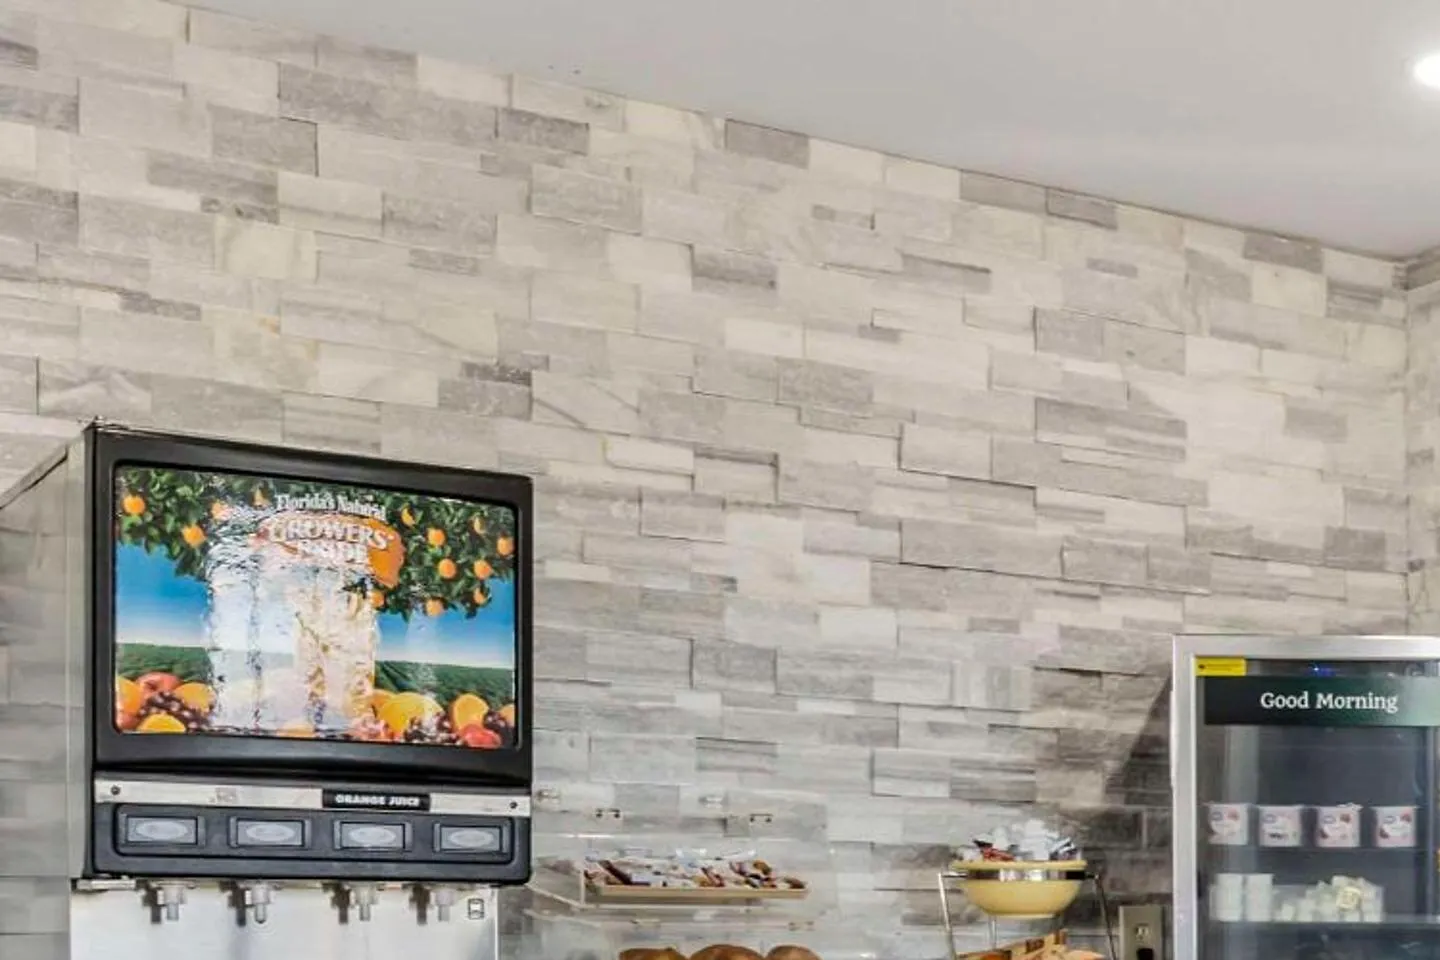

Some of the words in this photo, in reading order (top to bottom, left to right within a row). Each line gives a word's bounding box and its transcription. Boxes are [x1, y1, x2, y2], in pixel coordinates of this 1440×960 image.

[337, 495, 387, 521] Natural
[1260, 691, 1308, 708] Good
[1316, 691, 1399, 714] Morning
[336, 794, 386, 805] ORANGE
